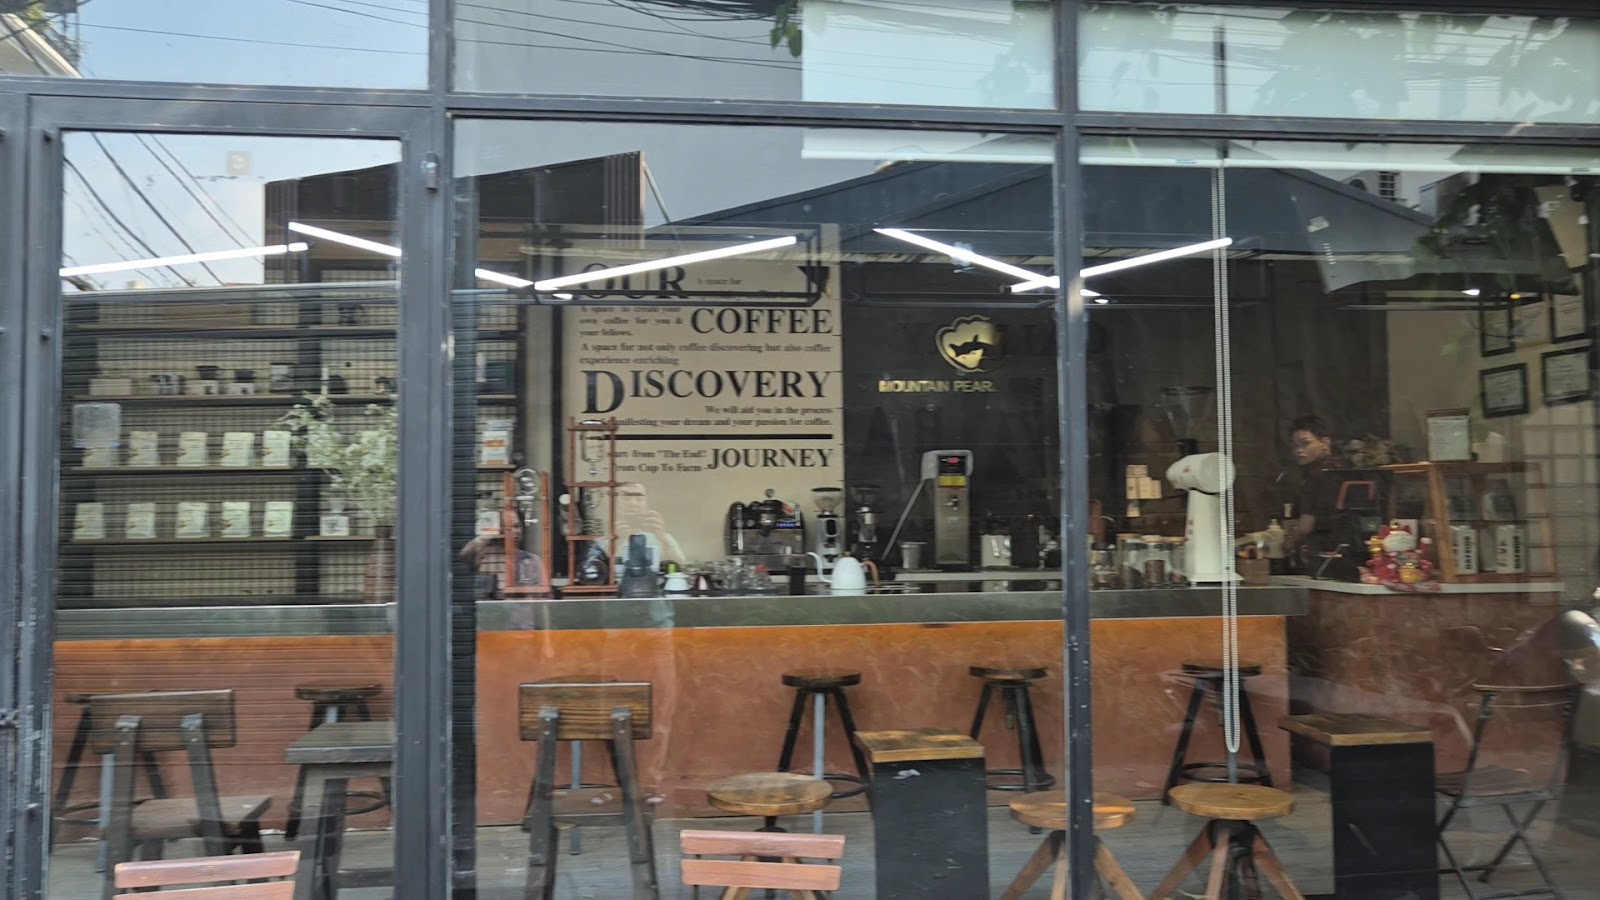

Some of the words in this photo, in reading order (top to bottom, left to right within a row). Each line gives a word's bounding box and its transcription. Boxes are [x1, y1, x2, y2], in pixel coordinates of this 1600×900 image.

[579, 263, 690, 299] OUR
[655, 318, 671, 326] you
[690, 308, 833, 334] COFFEE
[579, 330, 600, 338] your
[582, 343, 589, 351] A
[591, 344, 617, 353] space
[620, 343, 636, 351] for
[655, 343, 676, 353] only
[678, 343, 706, 351] coffee
[708, 343, 763, 354] discovering
[765, 343, 781, 352] but
[784, 344, 801, 352] also
[803, 344, 831, 352] coffee
[579, 356, 631, 366] experience
[633, 356, 680, 366] enriching
[580, 369, 831, 414] DISCOVERY
[878, 380, 950, 392] MOUNTAIN
[704, 405, 721, 413] We
[722, 405, 739, 413] will
[755, 407, 771, 416] you
[801, 408, 833, 416] process
[660, 419, 681, 428] your
[732, 419, 752, 428] your
[755, 418, 788, 428] passion
[707, 448, 834, 469] JOURNEY
[638, 463, 659, 473] Cup
[661, 463, 674, 471] To
[676, 463, 703, 471] Farm
